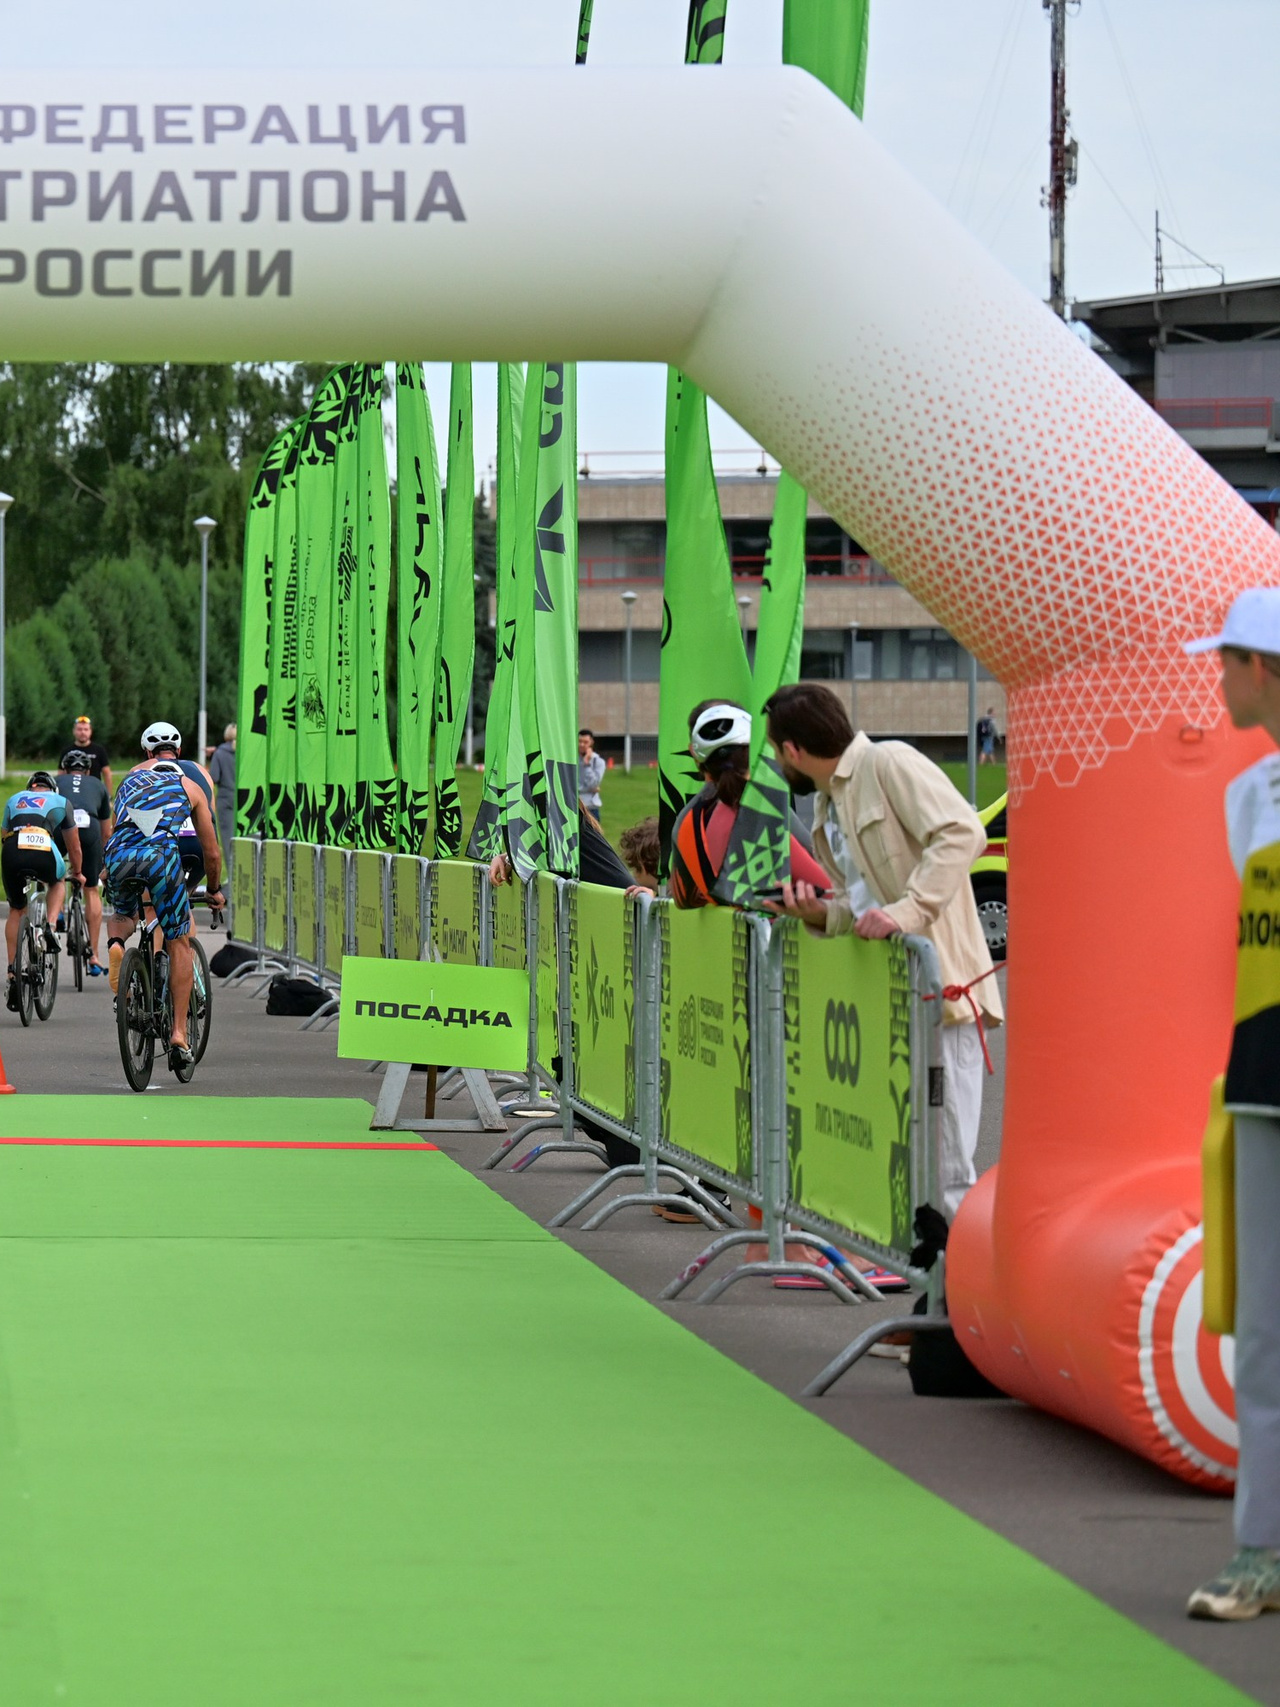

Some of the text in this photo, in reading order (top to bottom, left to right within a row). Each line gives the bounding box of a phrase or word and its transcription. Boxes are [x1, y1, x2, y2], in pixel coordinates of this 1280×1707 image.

[26, 835, 45, 844] 1078
[600, 974, 615, 1020] сбп
[355, 1000, 513, 1028] ПОСАДКА
